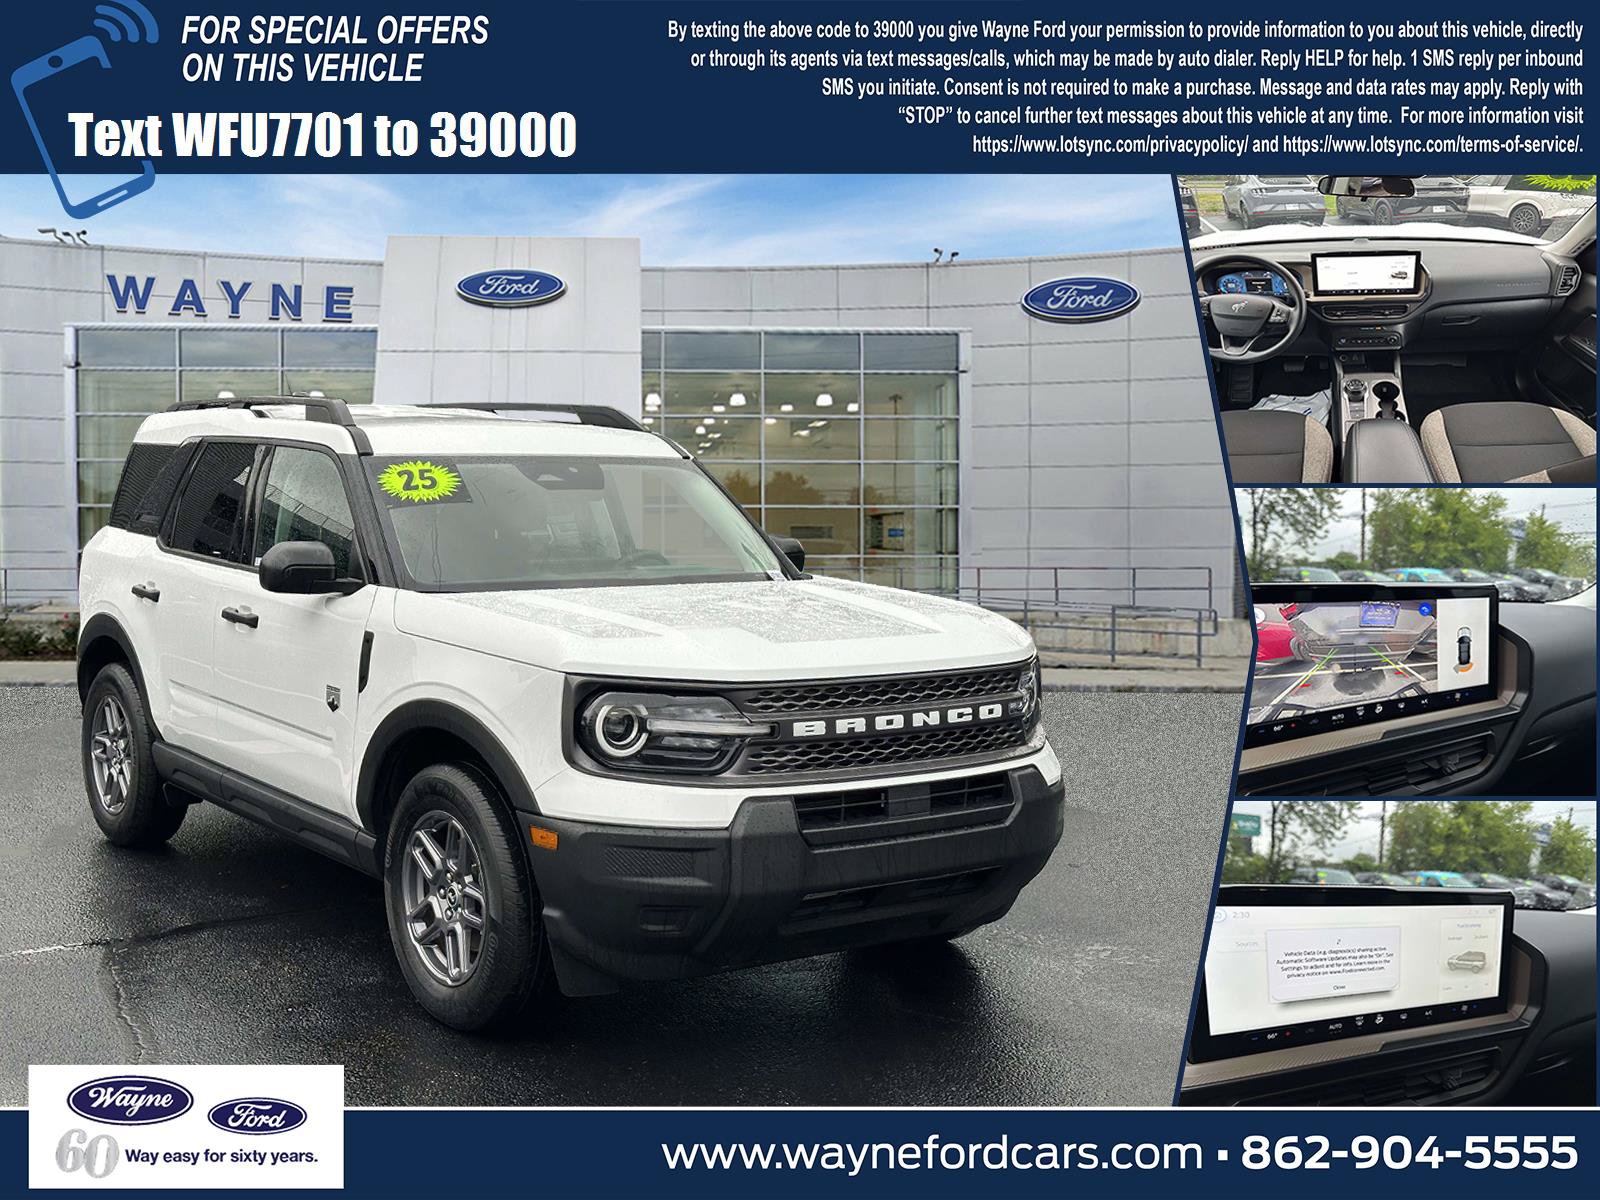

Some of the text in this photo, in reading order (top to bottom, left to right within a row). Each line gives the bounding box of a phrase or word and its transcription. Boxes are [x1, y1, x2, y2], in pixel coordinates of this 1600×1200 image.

[479, 274, 540, 295] Ford
[1046, 284, 1114, 309] Ford
[106, 274, 354, 321] WAYNE
[396, 468, 438, 491] 25
[792, 702, 1003, 738] BRONCO
